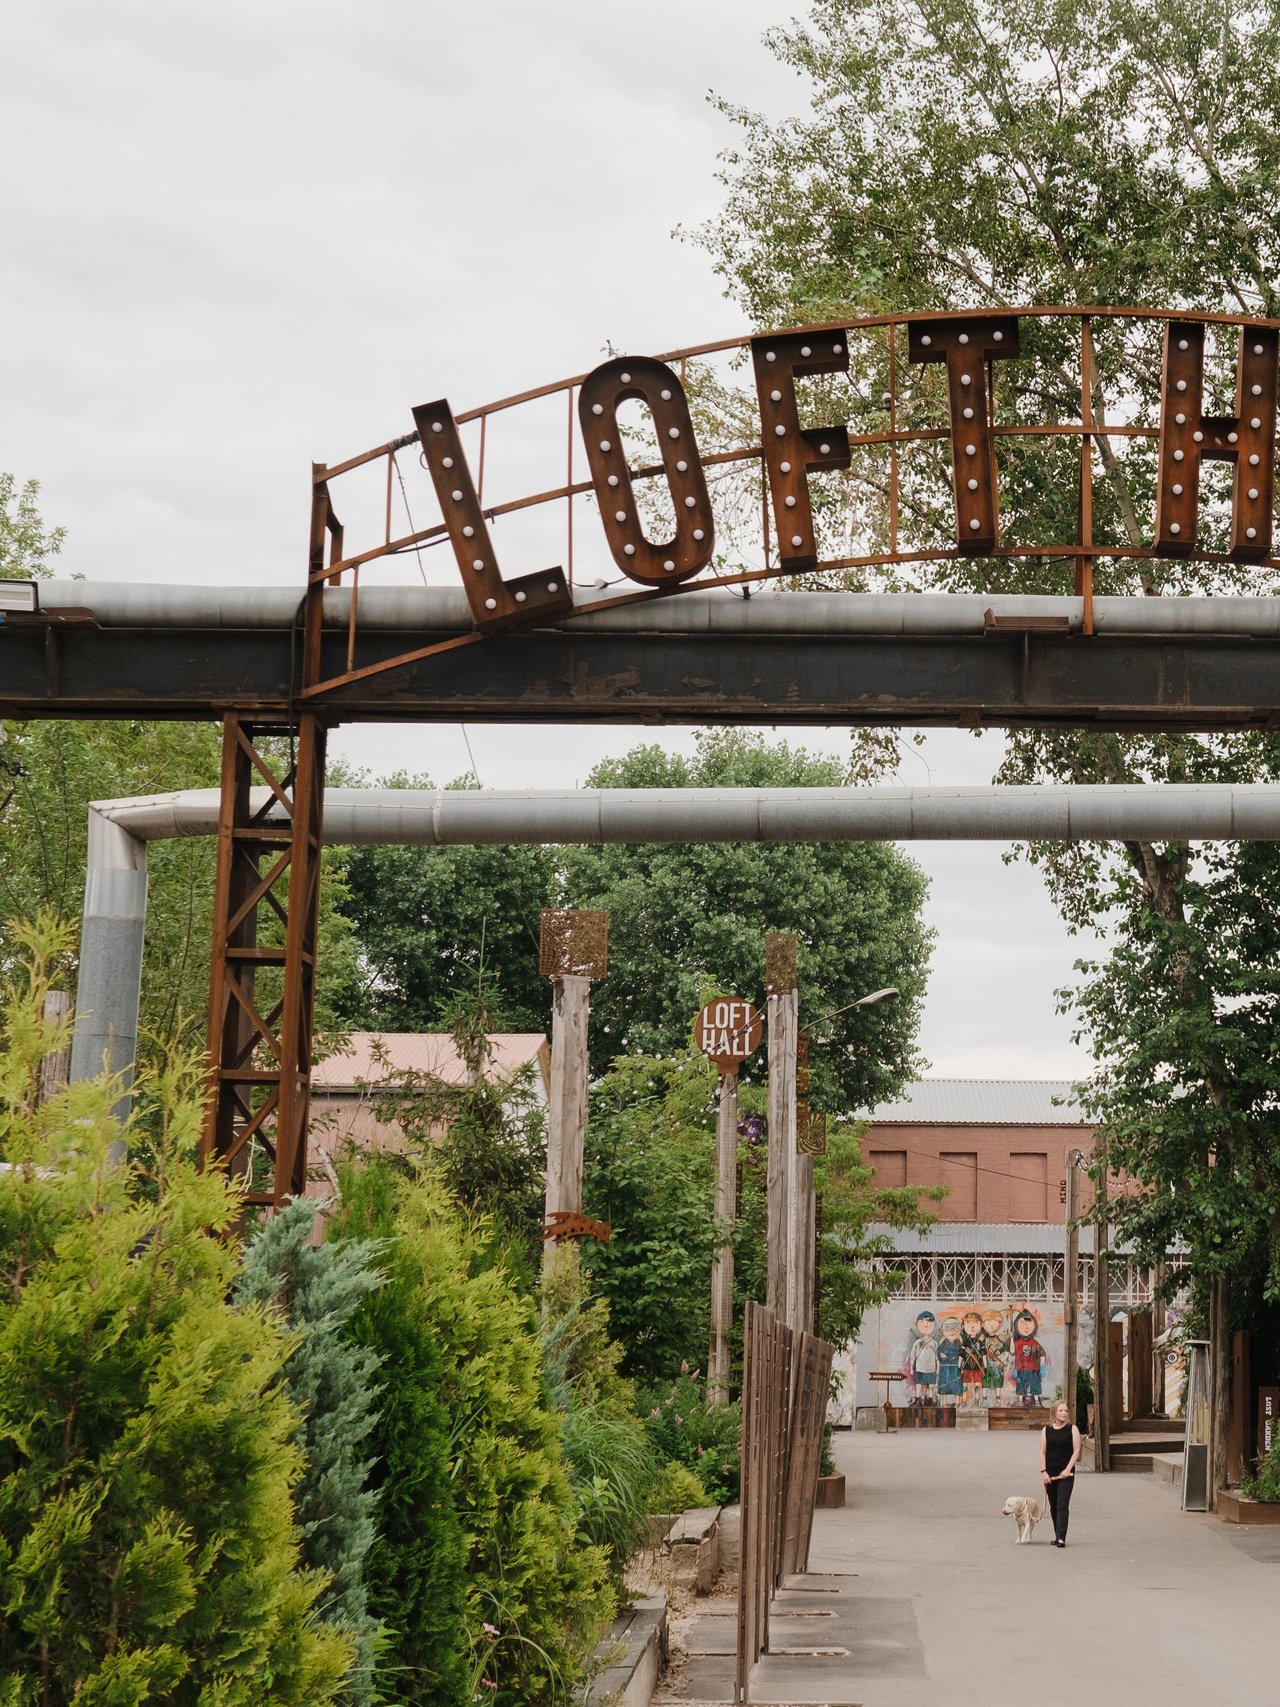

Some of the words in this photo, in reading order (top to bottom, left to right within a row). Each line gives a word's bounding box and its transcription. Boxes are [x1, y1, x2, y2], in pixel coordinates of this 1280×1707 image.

[411, 316, 1020, 633] LOFT
[702, 1003, 752, 1028] LOFT
[702, 1029, 753, 1055] HALL
